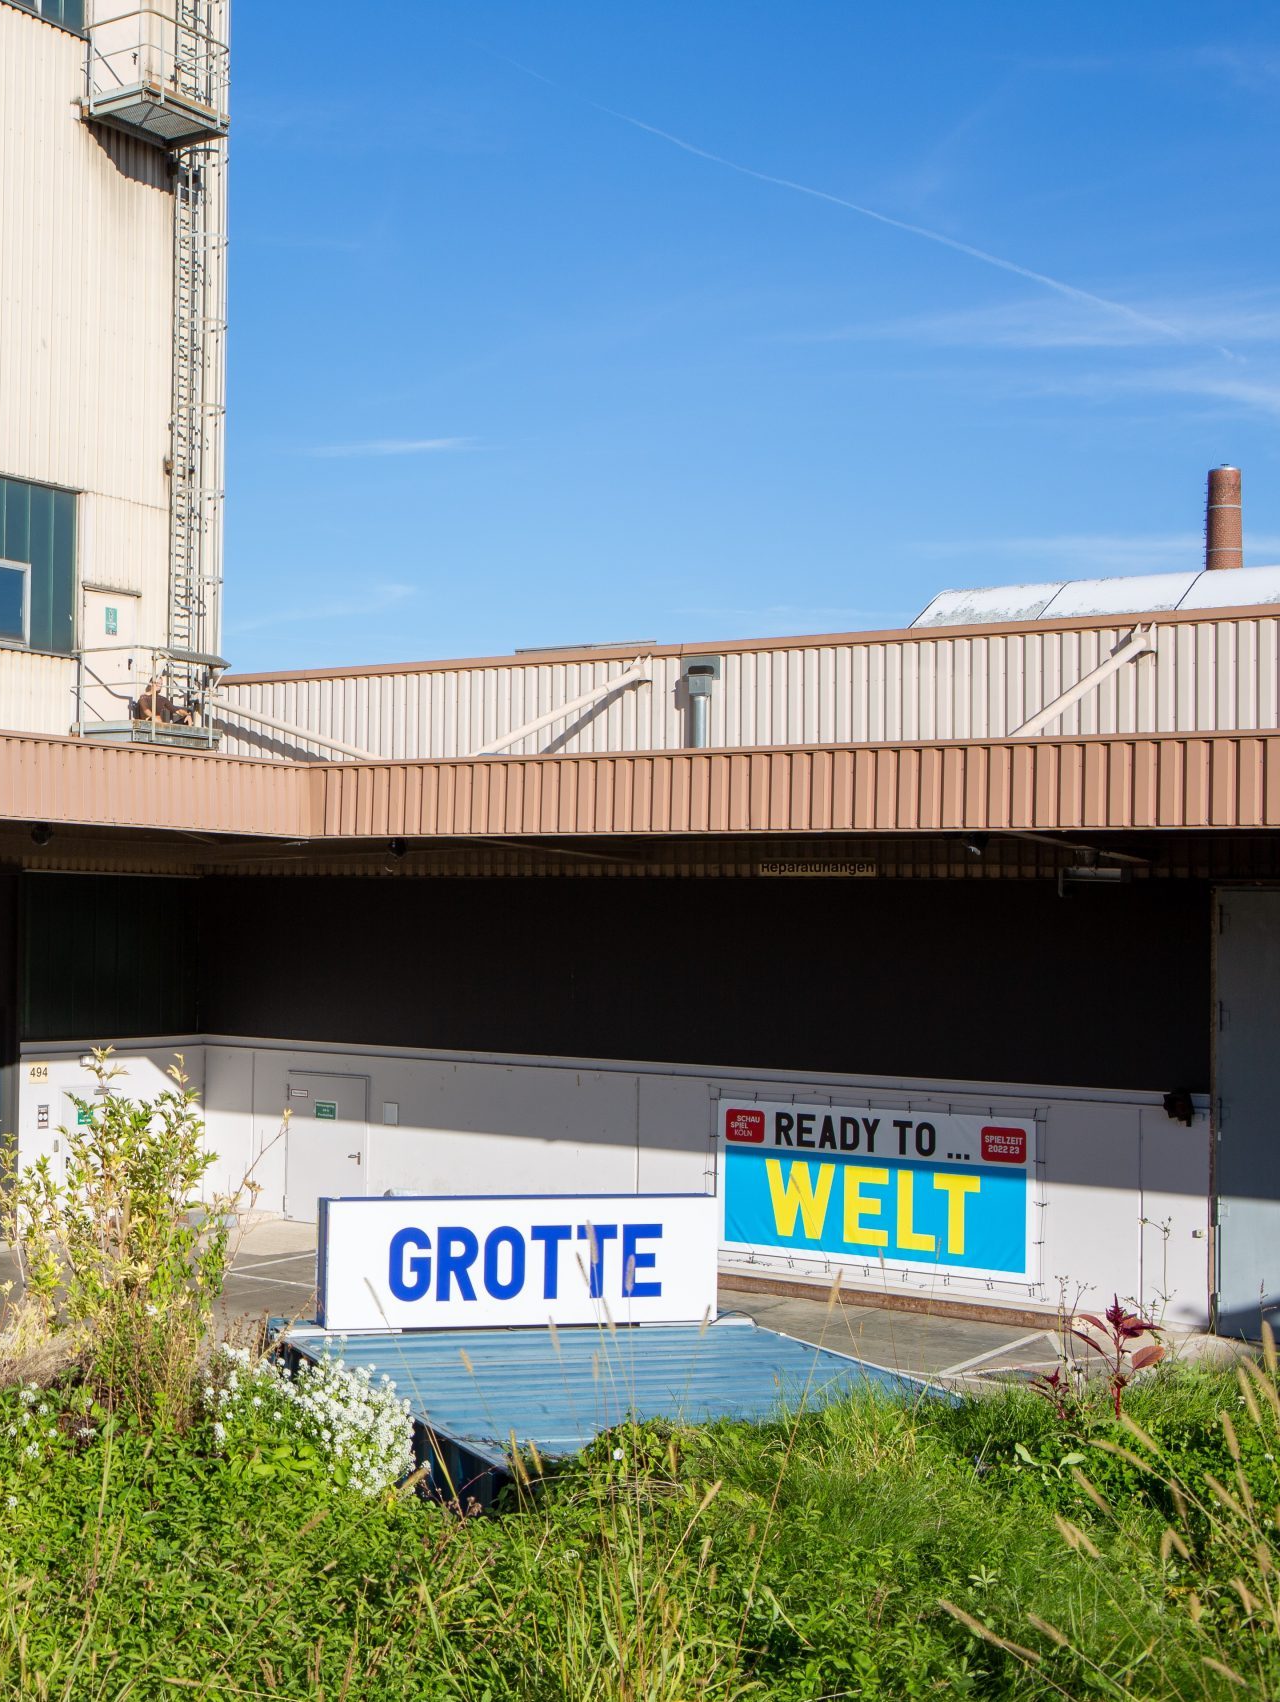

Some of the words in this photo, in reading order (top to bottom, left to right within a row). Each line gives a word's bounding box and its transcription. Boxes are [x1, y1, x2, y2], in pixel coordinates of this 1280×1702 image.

[30, 1067, 48, 1078] 494
[736, 1114, 760, 1123] SCHAU
[730, 1121, 749, 1129] SPIEL
[734, 1127, 753, 1137] KÖLN
[775, 1111, 881, 1153] READY
[892, 1120, 936, 1157] TO
[984, 1135, 1024, 1146] SPIELZEIT
[988, 1144, 1009, 1154] 2022
[1009, 1146, 1020, 1154] 23
[765, 1158, 981, 1255] WELT
[388, 1223, 663, 1302] GROTTE
